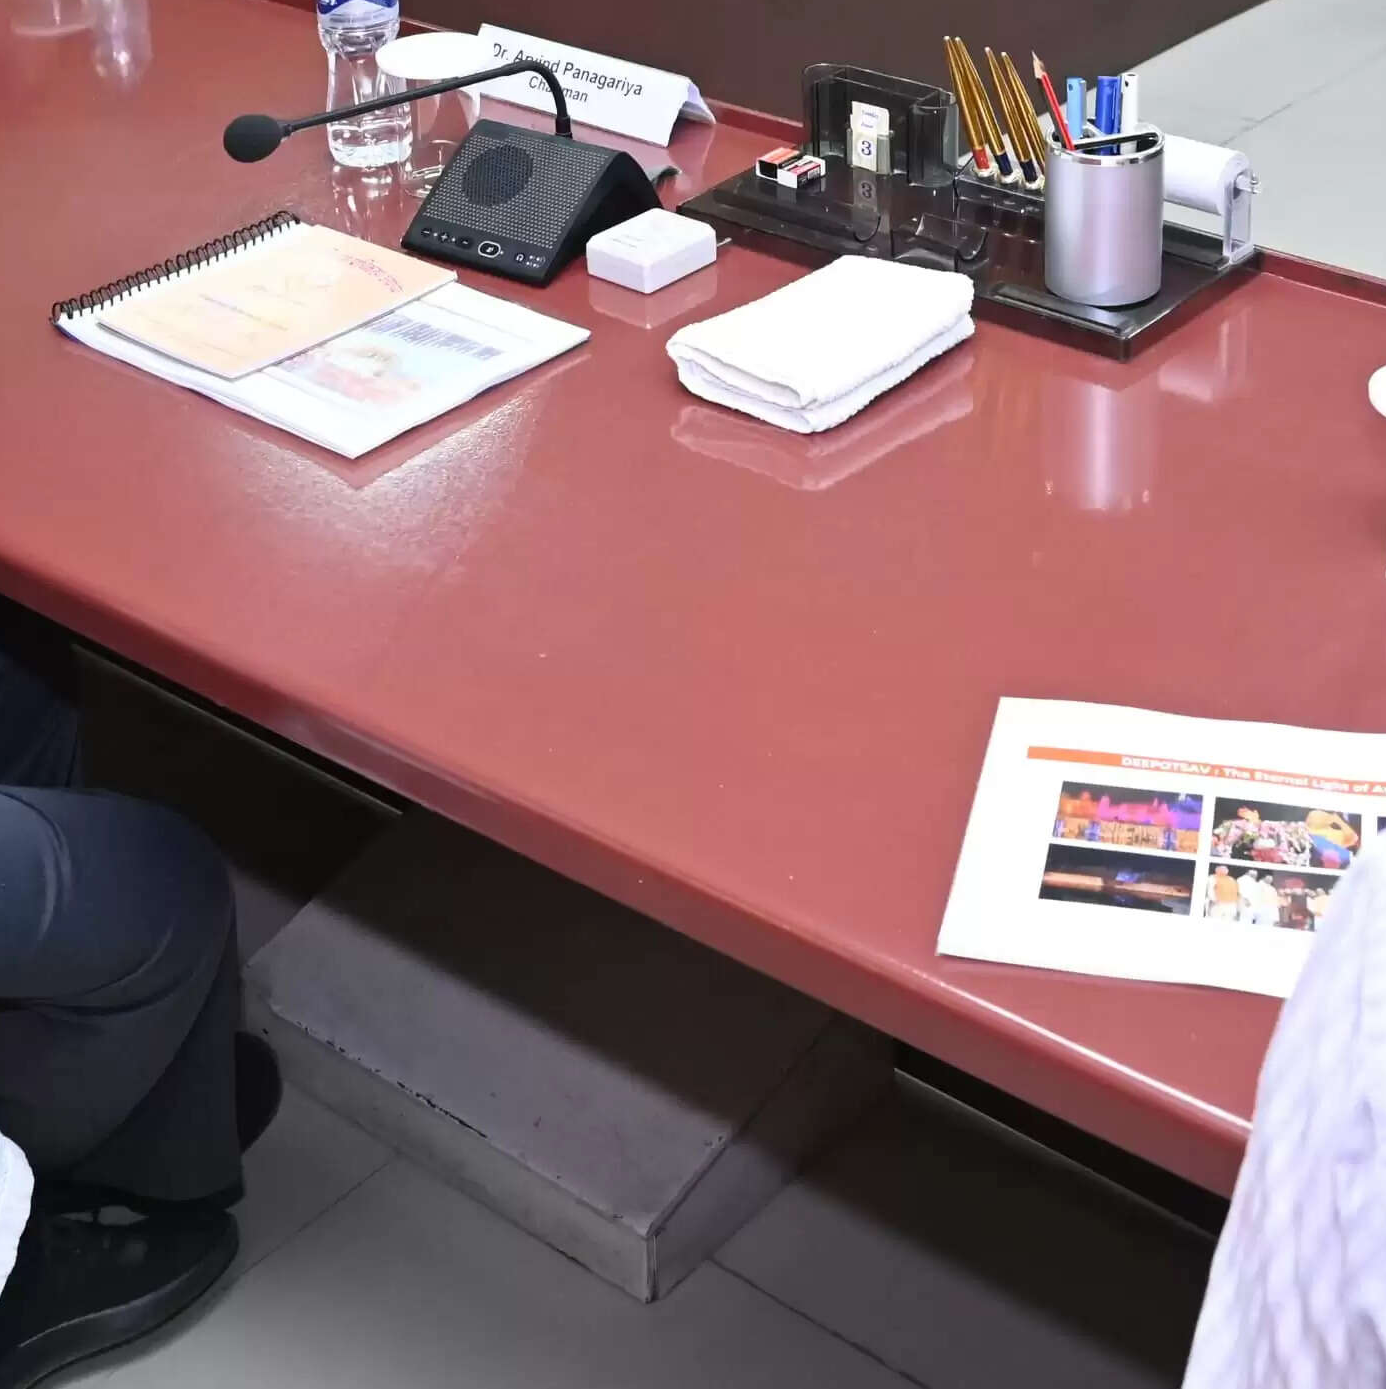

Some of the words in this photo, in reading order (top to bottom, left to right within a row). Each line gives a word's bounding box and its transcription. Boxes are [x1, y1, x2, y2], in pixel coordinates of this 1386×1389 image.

[493, 43, 510, 61] Dr.
[563, 61, 644, 97] Panagariya
[529, 75, 589, 103] Chaman
[861, 140, 872, 156] 3
[1121, 755, 1211, 774] DEEPOTSAV
[1224, 766, 1250, 780] The
